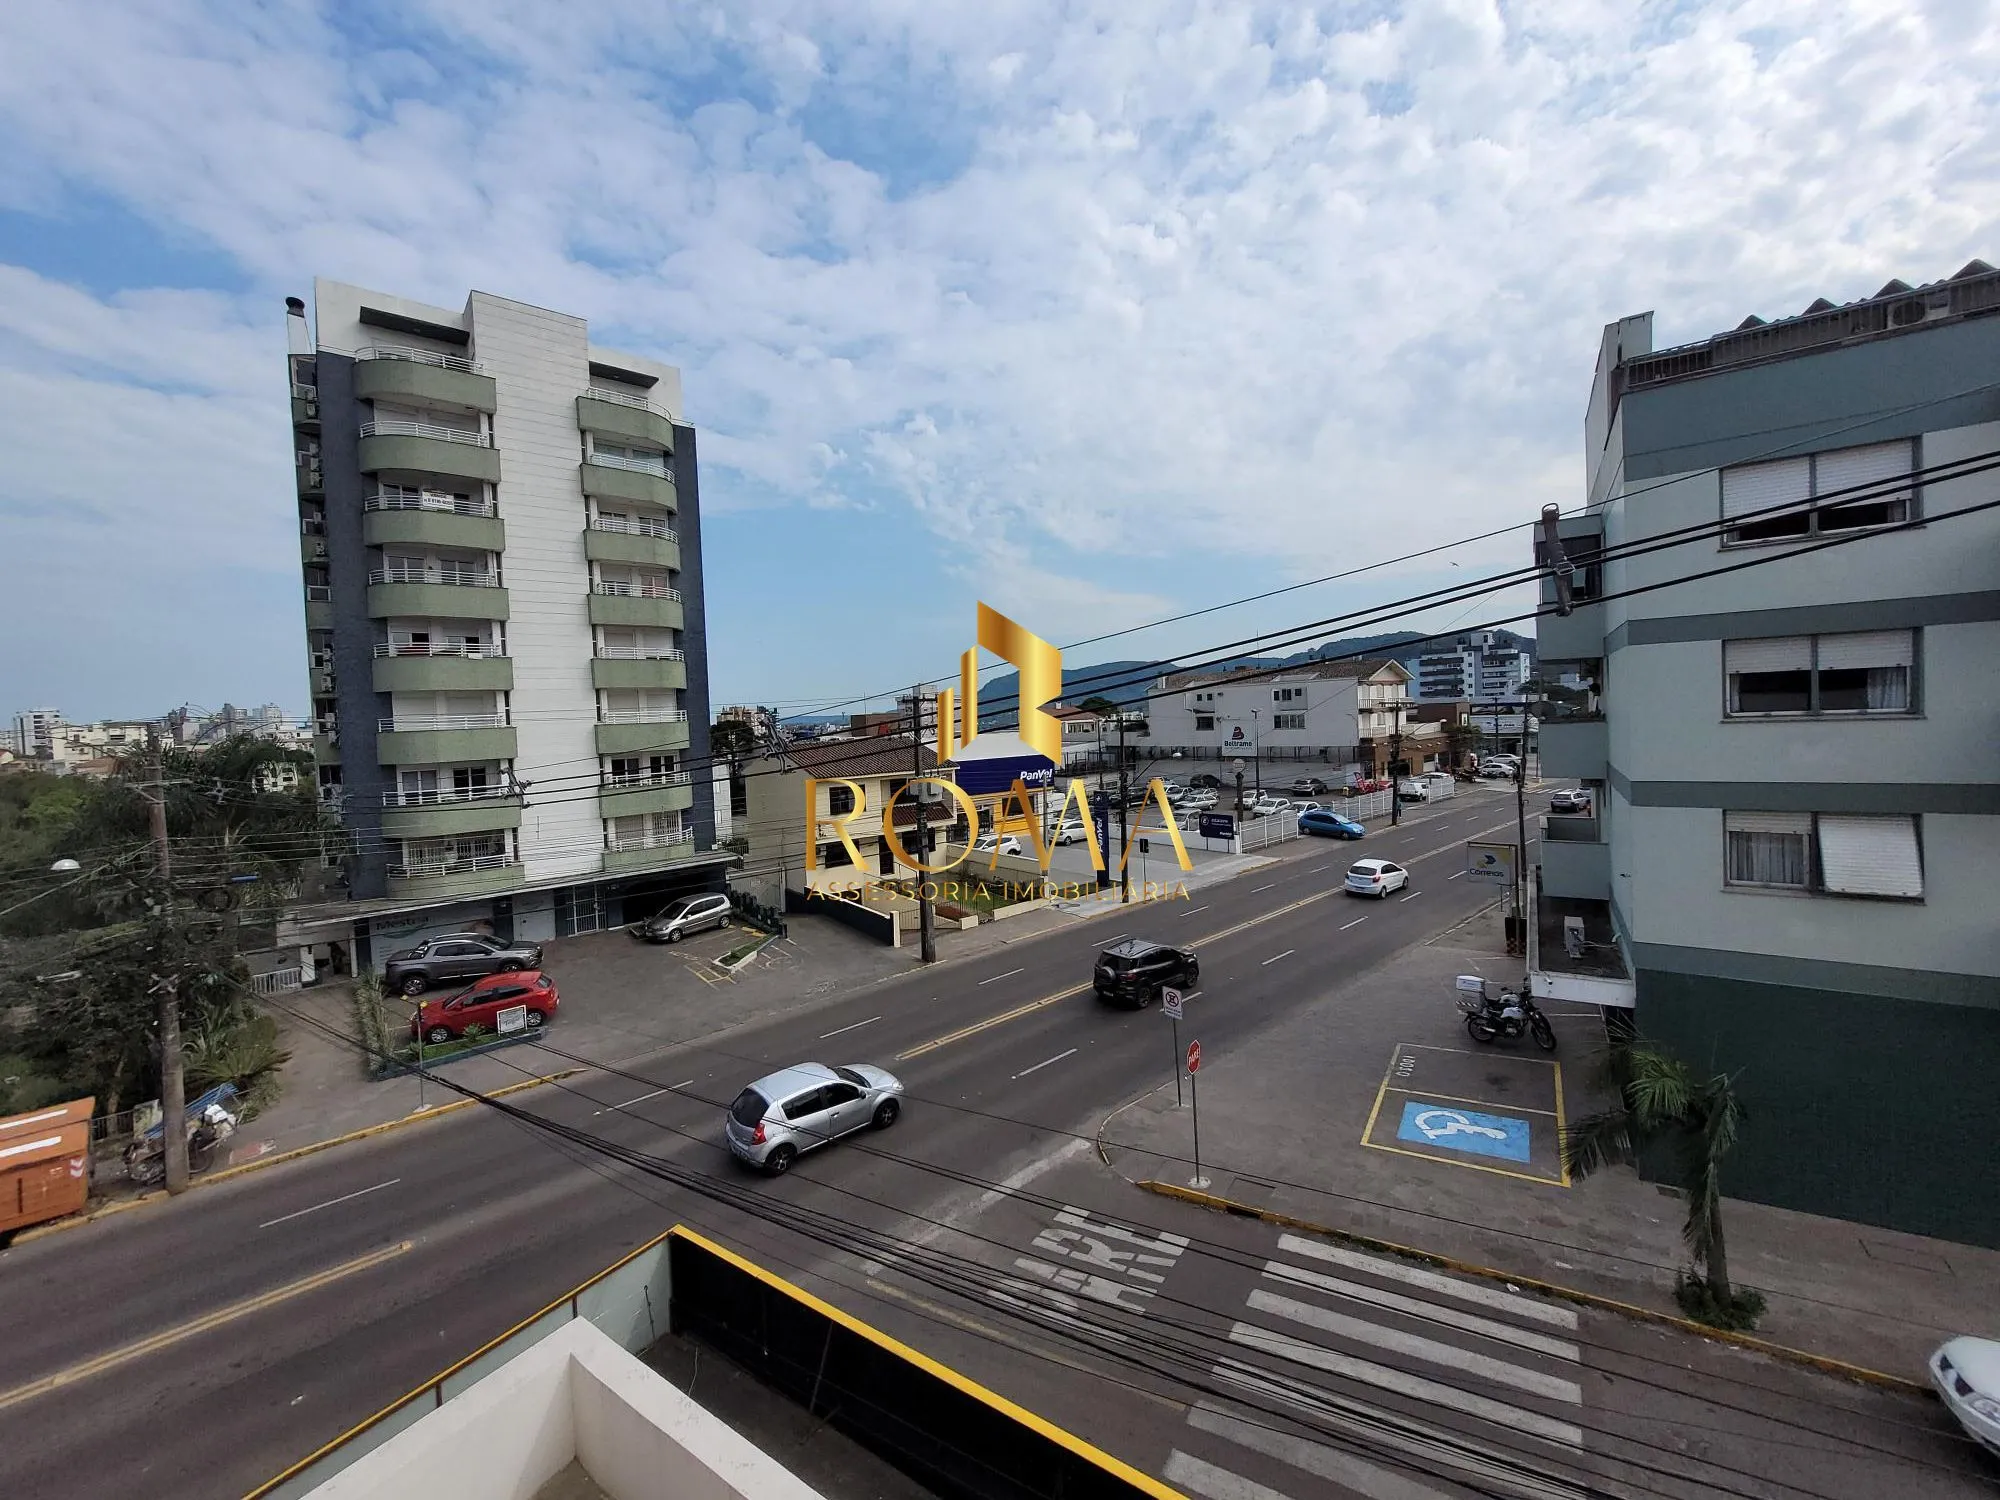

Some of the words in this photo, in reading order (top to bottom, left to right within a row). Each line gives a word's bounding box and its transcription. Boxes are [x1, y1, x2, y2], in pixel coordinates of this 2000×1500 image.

[1469, 868, 1504, 877] Correios
[1188, 1048, 1200, 1066] PARE
[986, 1204, 1191, 1342] PARE
